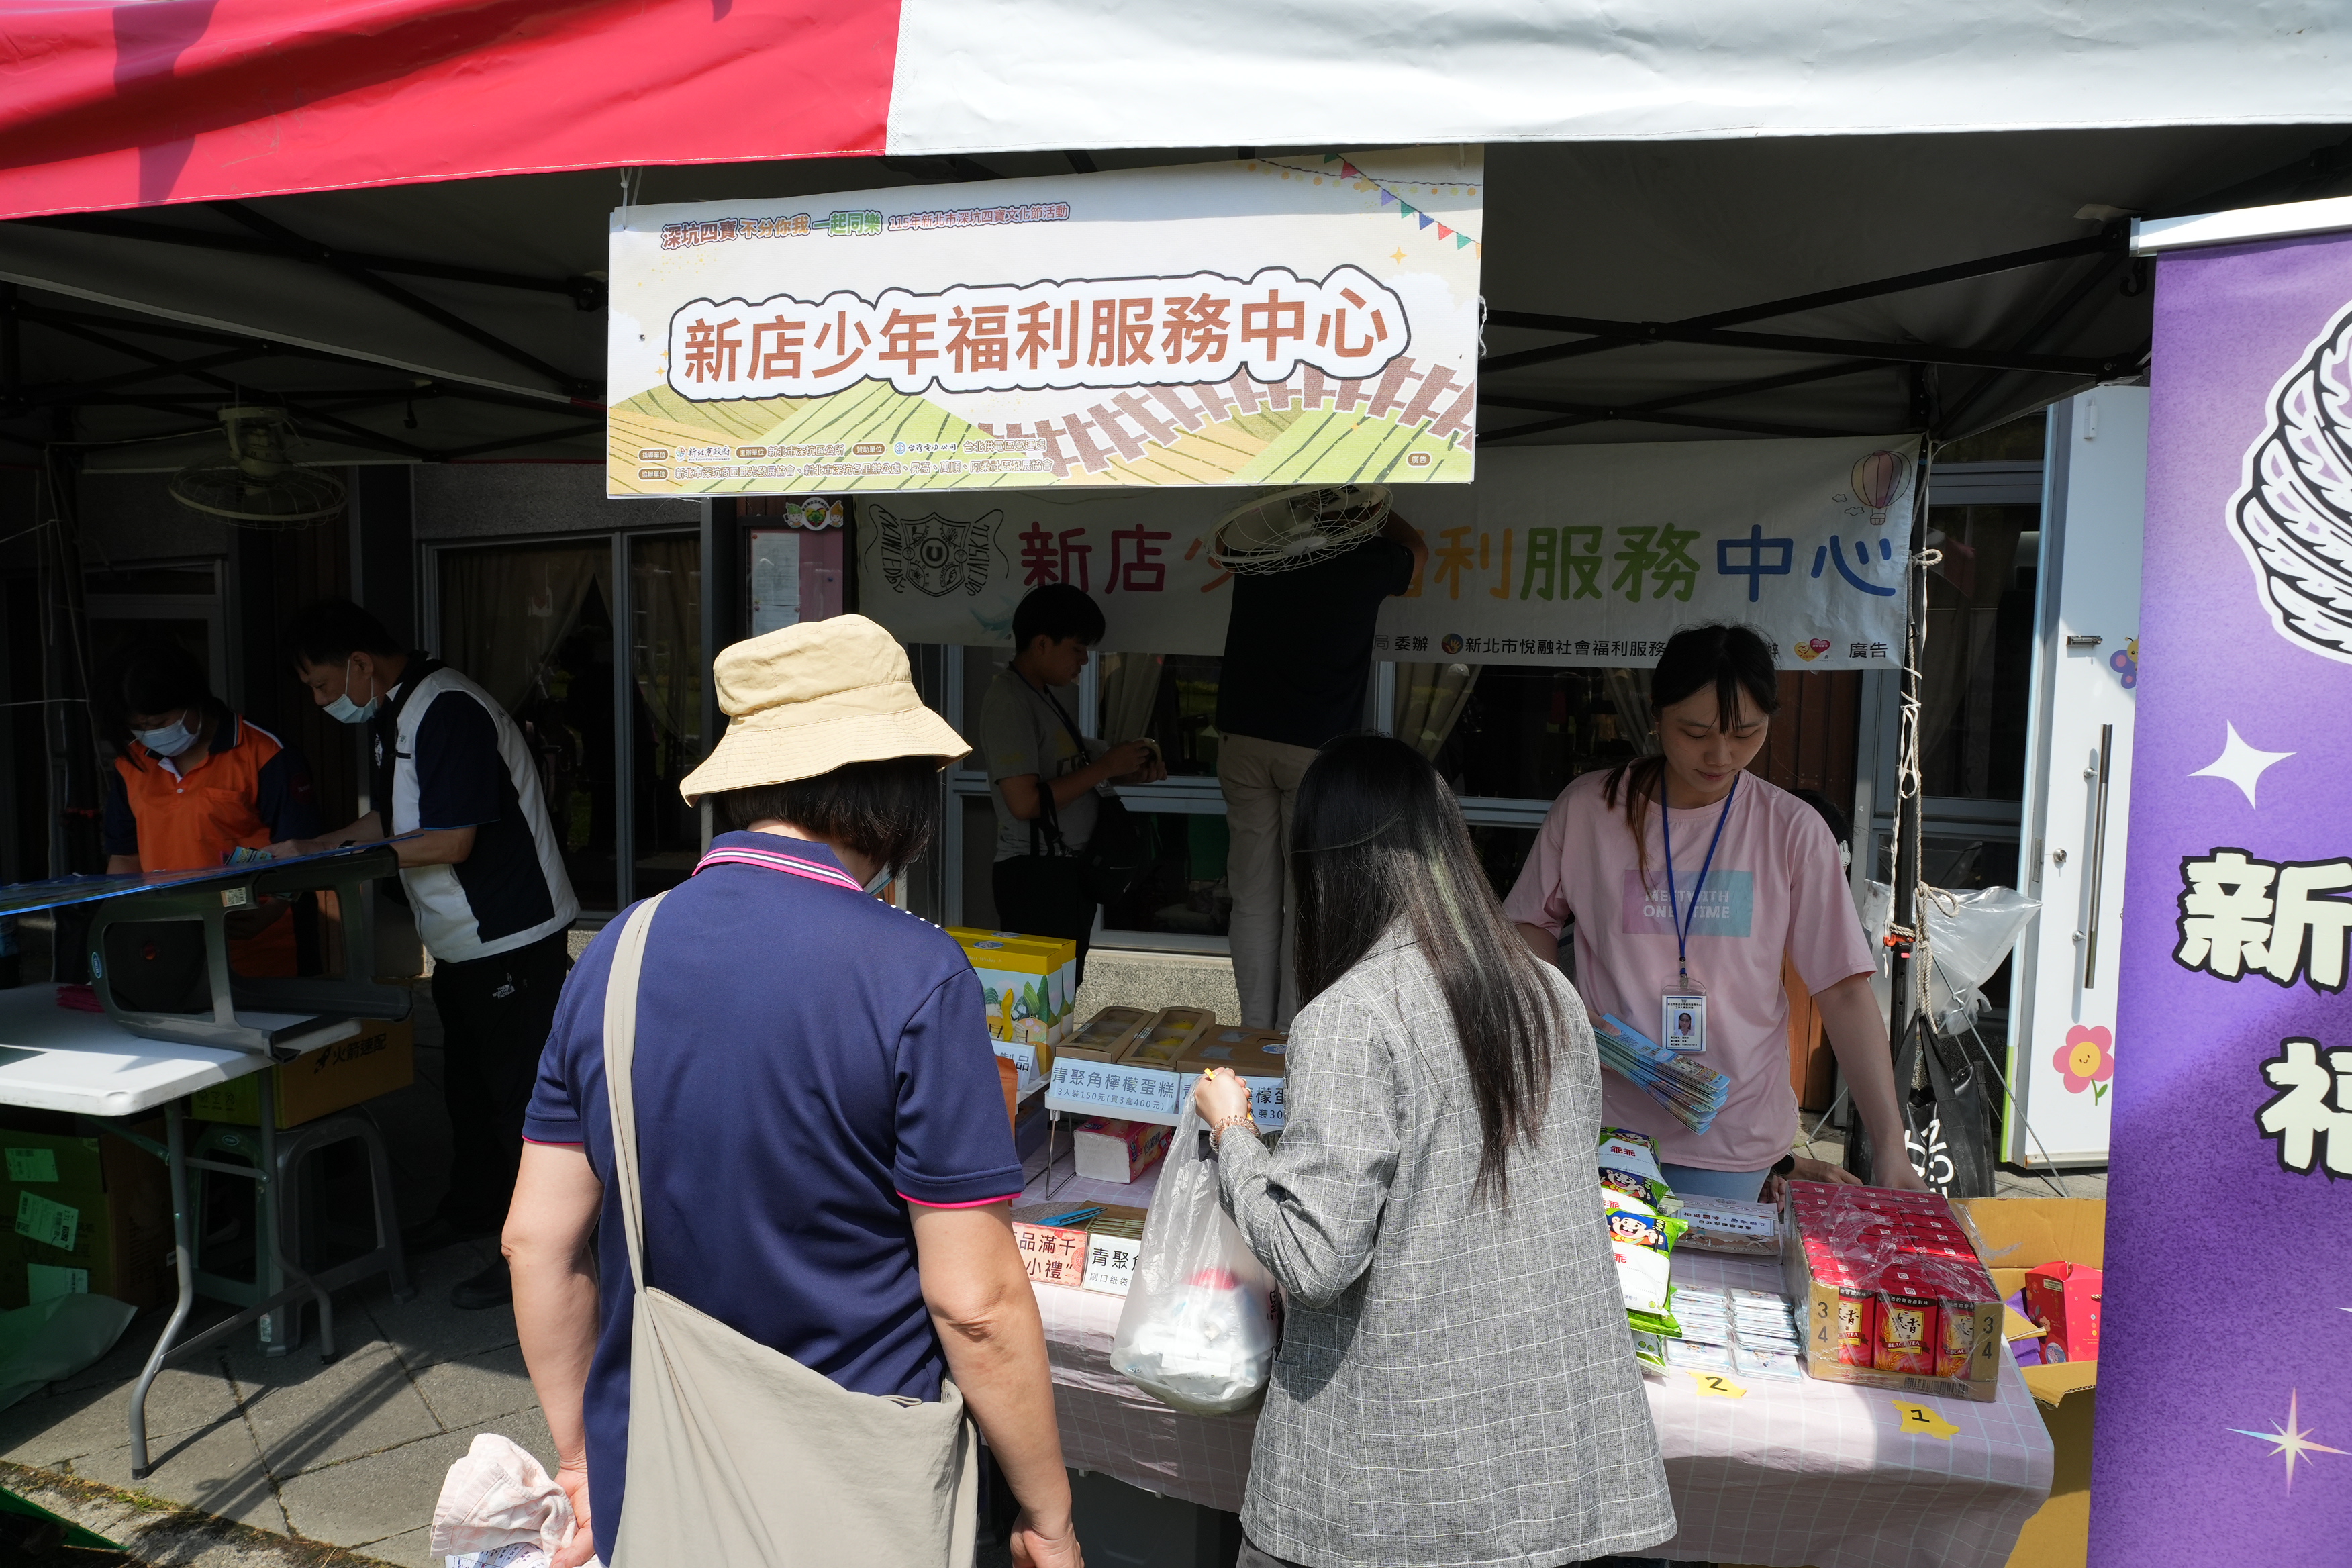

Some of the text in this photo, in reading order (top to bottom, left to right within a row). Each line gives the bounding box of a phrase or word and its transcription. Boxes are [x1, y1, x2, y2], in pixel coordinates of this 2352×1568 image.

[663, 204, 1069, 249] 深坑四寶 不分你我 一起同樂 115年新北市深坑四寶文化節活動
[685, 287, 1388, 383] 新店少年福利服務中心
[642, 446, 731, 459] 指導單位 新北市政府
[739, 444, 845, 457] 主辦單位 新北市深坑區公所
[856, 445, 883, 454] 贊助單位
[963, 439, 1047, 452] 台北供電區營運處
[1410, 454, 1428, 464] 廣告
[642, 470, 667, 479] 協辦單位
[939, 561, 955, 588] COURAGE
[1395, 636, 1428, 652] 委辦
[1849, 642, 1888, 659] 廣告
[1643, 905, 1730, 918] ONE TIME
[332, 1032, 387, 1065] 火箭速配
[1052, 1067, 1175, 1099] 青聚角檸檬蛋糕
[1057, 1087, 1165, 1111] 3入裝150元(買3盒400元)
[1610, 1145, 1636, 1157] 乖乖
[1014, 1231, 1077, 1257] 品滿千
[1817, 1301, 1828, 1319] 3
[1983, 1316, 1994, 1334] 3
[1817, 1326, 1828, 1343] 4
[1981, 1341, 1992, 1359] 4
[1706, 1376, 1729, 1393] 2
[1910, 1408, 1930, 1424] 1
